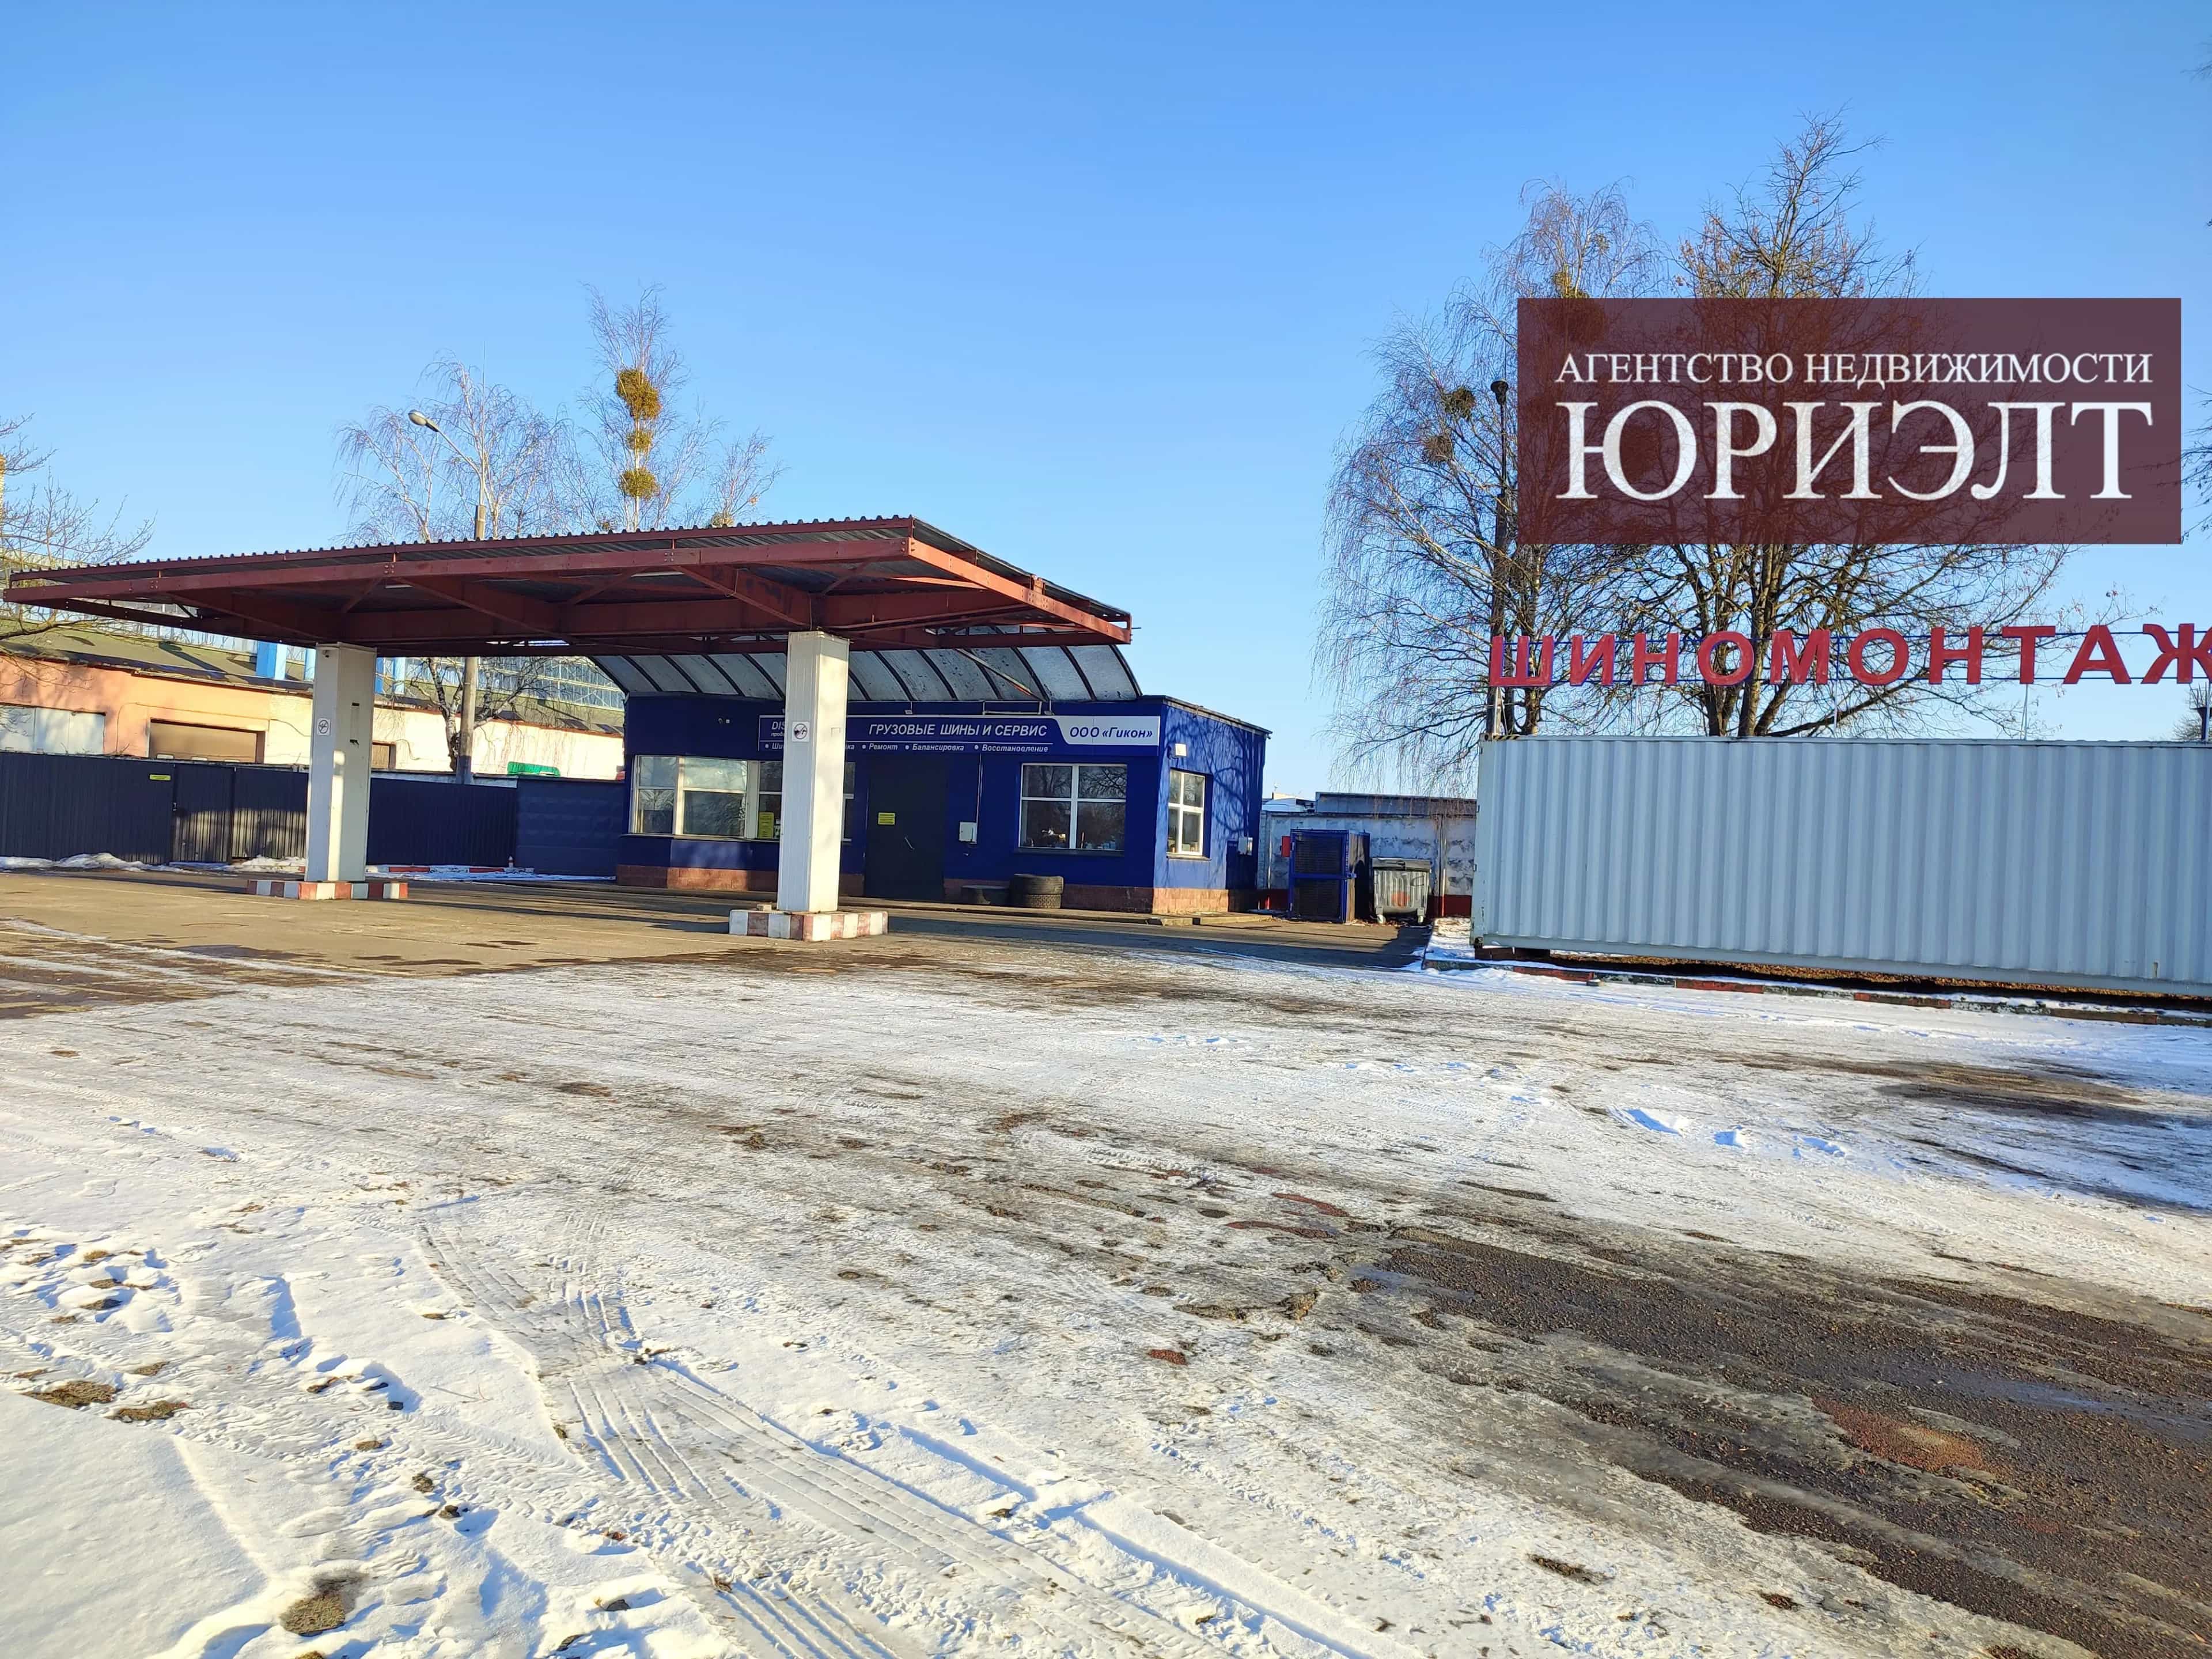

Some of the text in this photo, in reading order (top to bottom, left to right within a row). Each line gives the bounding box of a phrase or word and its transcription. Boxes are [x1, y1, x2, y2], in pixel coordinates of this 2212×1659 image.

[1490, 623, 2212, 687] ШИНОМОНТАЖ
[869, 724, 1047, 736] ГРУЗОВЫЕ ШИНЫ И СЕРВИС
[1070, 727, 1153, 738] ООО «Гикон»
[912, 744, 964, 752] Балансировка
[982, 744, 1048, 752] Восстановление
